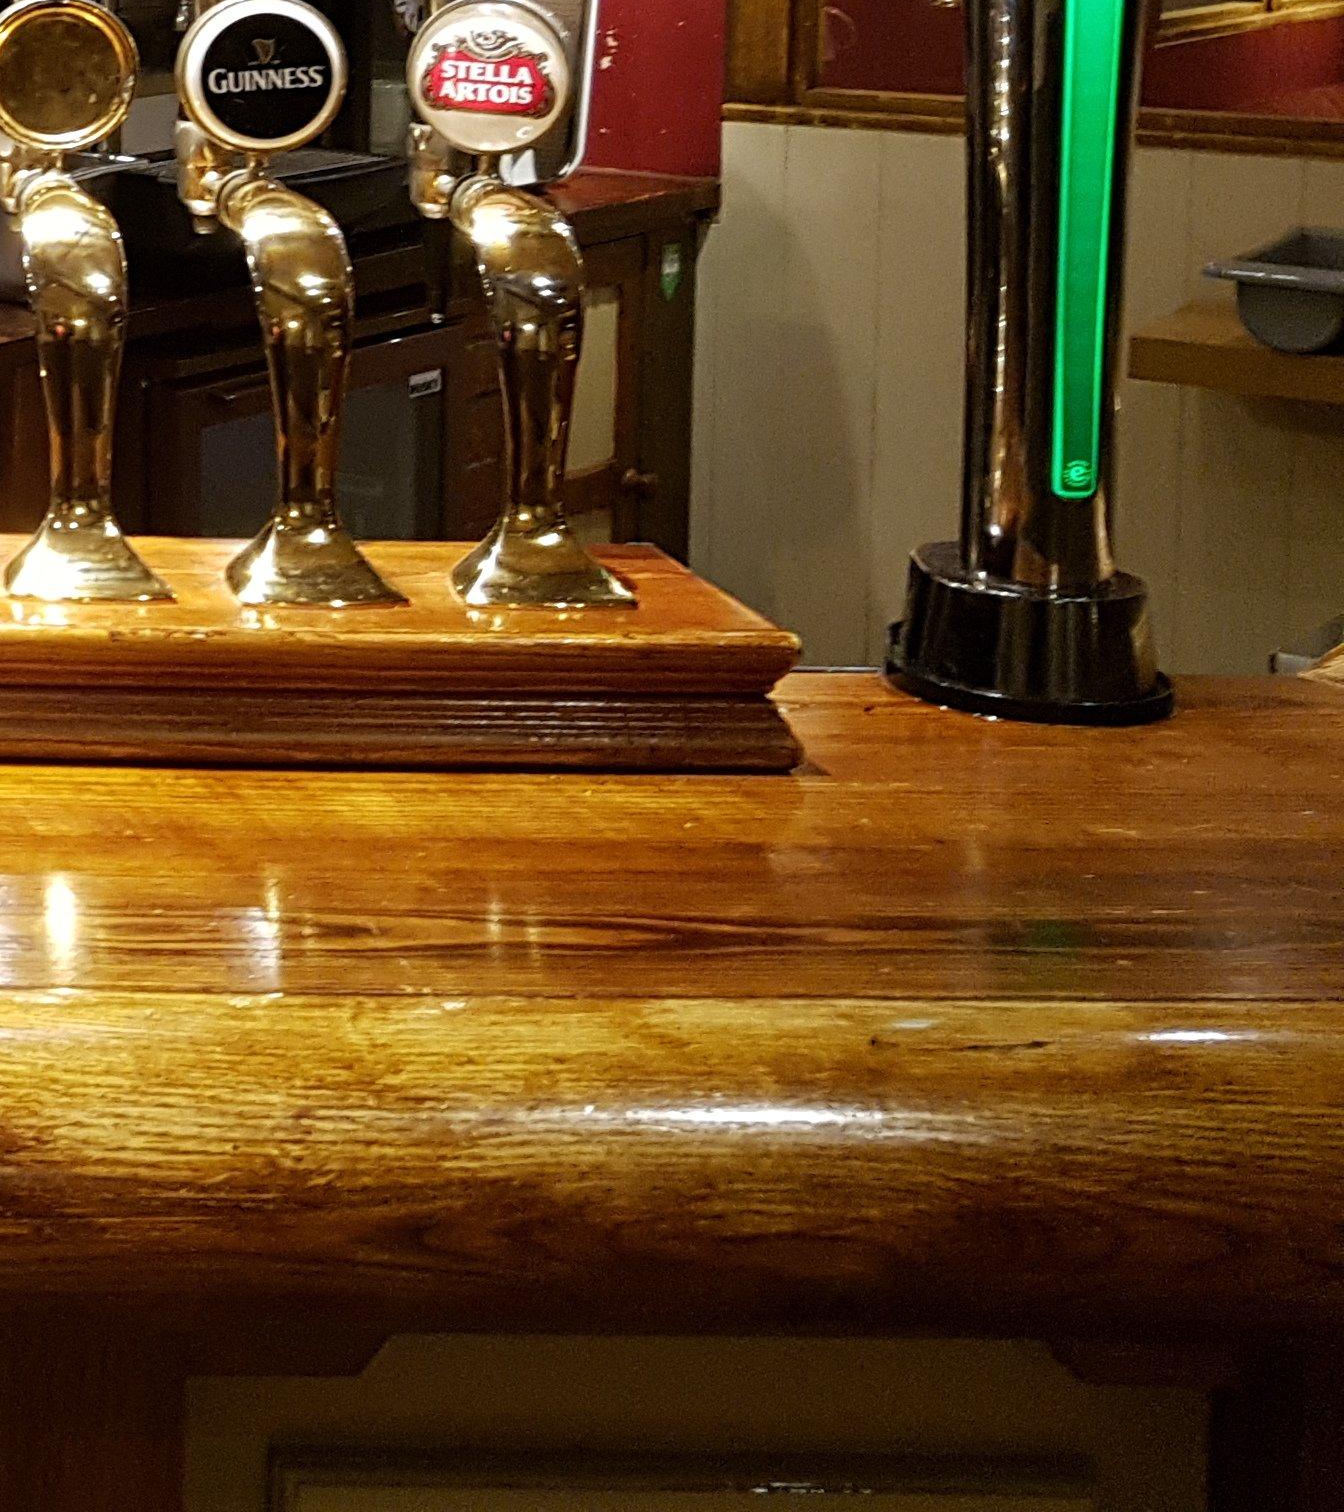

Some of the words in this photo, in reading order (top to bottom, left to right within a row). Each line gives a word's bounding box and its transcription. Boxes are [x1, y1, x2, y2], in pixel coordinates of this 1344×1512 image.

[207, 65, 326, 95] GUINNESS
[440, 59, 534, 85] STELLA
[438, 80, 534, 105] ARTOIS
